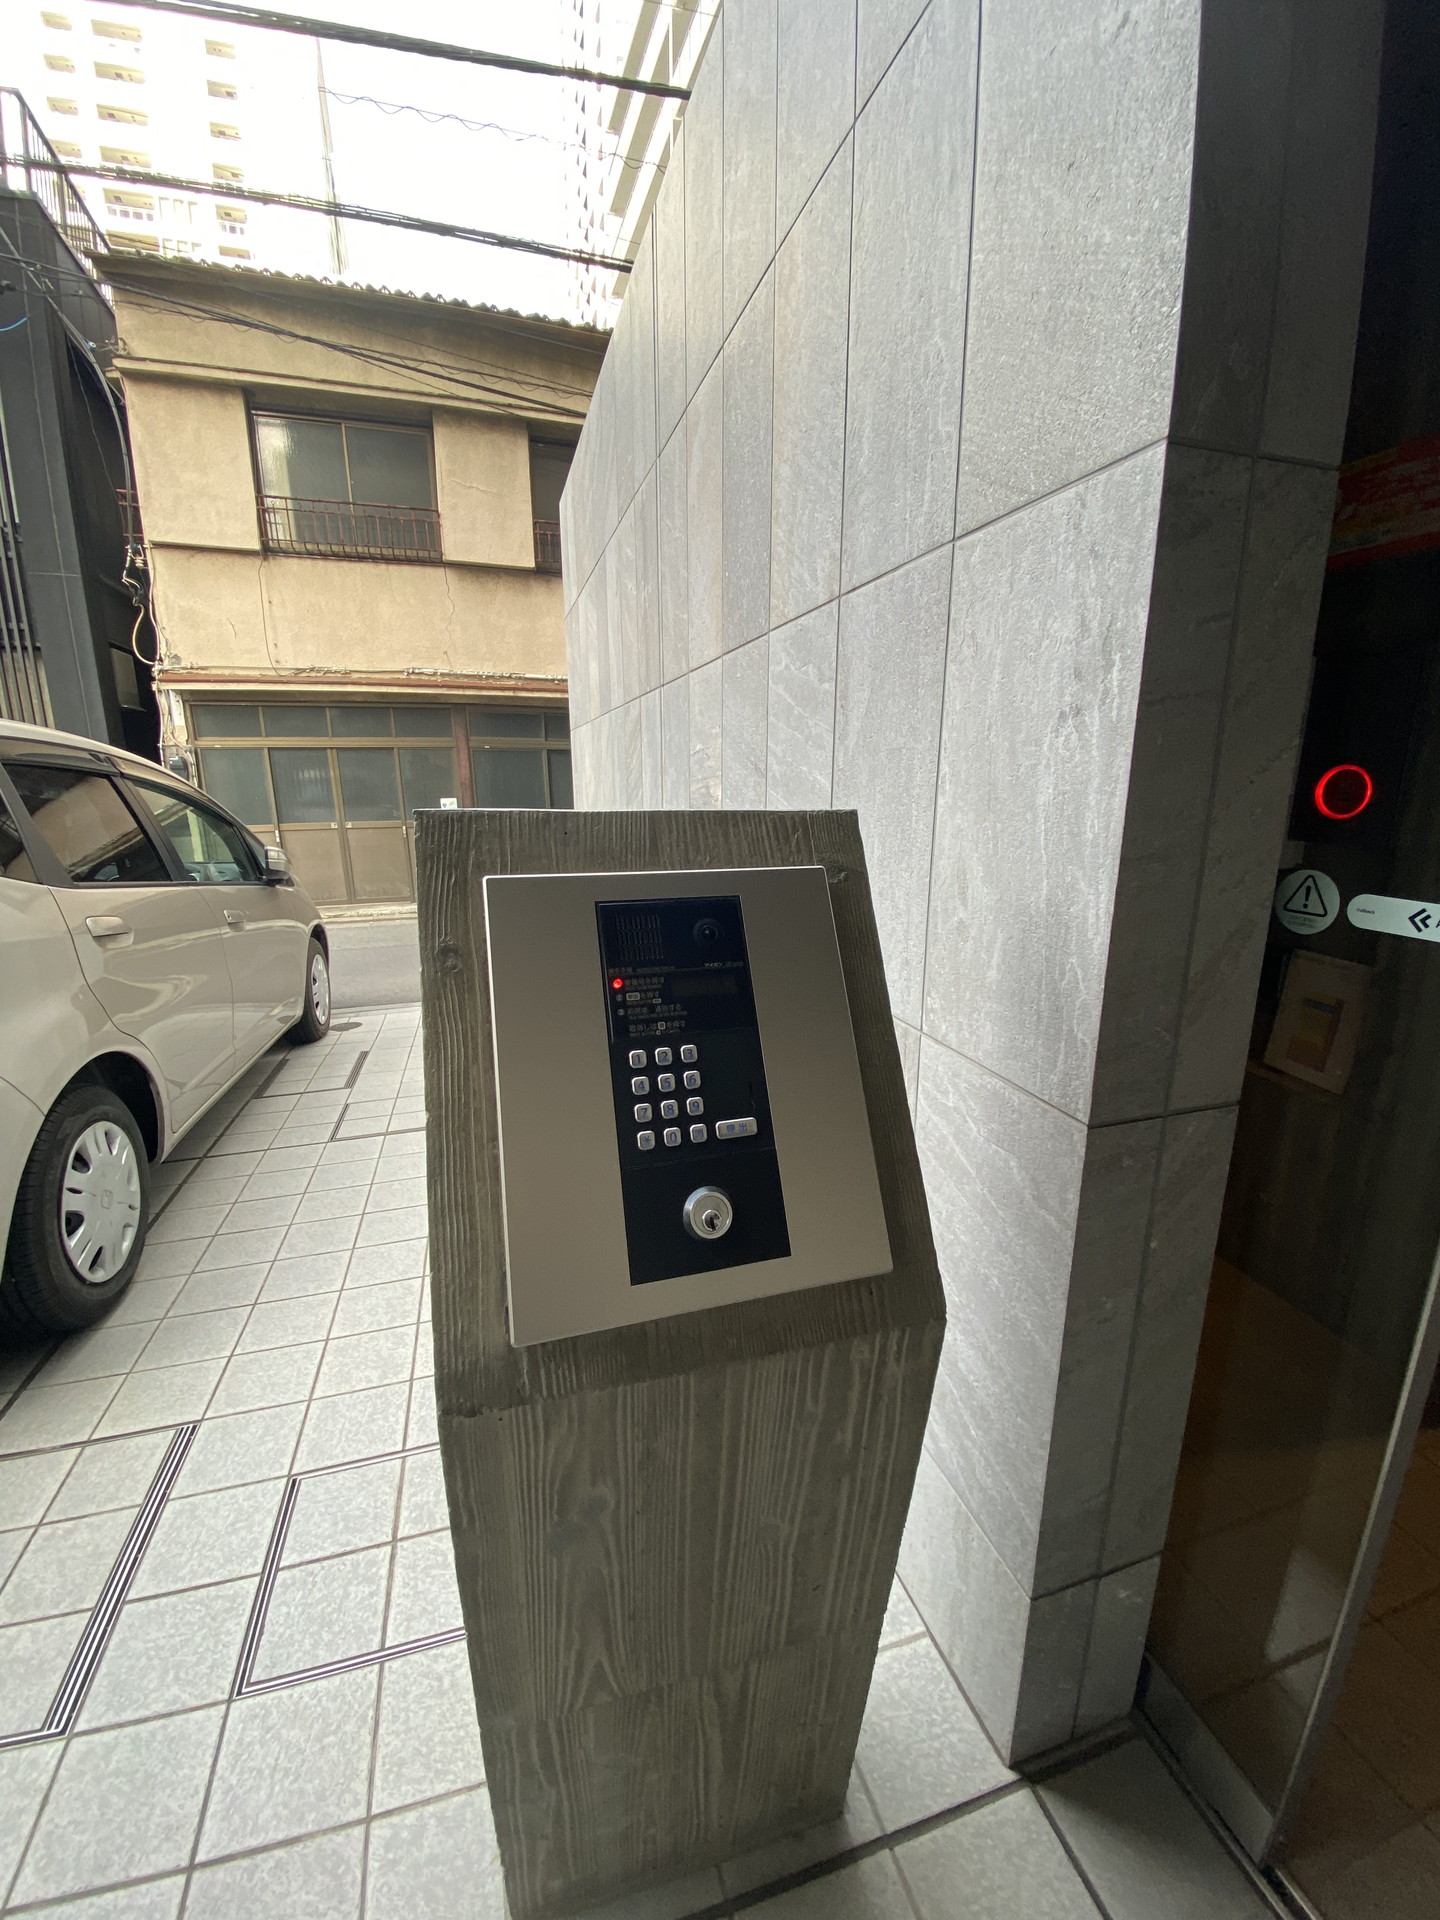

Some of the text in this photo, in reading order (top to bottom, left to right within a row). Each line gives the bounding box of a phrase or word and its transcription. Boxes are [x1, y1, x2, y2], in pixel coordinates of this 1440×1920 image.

[635, 1054, 641, 1064] 1
[661, 1051, 668, 1061] 2
[687, 1049, 694, 1059] 3
[664, 1077, 671, 1088] 5
[688, 1075, 696, 1085] 6
[638, 1081, 645, 1091] 4
[667, 1104, 674, 1115] 8
[692, 1100, 699, 1111] 9
[641, 1107, 648, 1117] 7
[670, 1132, 677, 1142] 0
